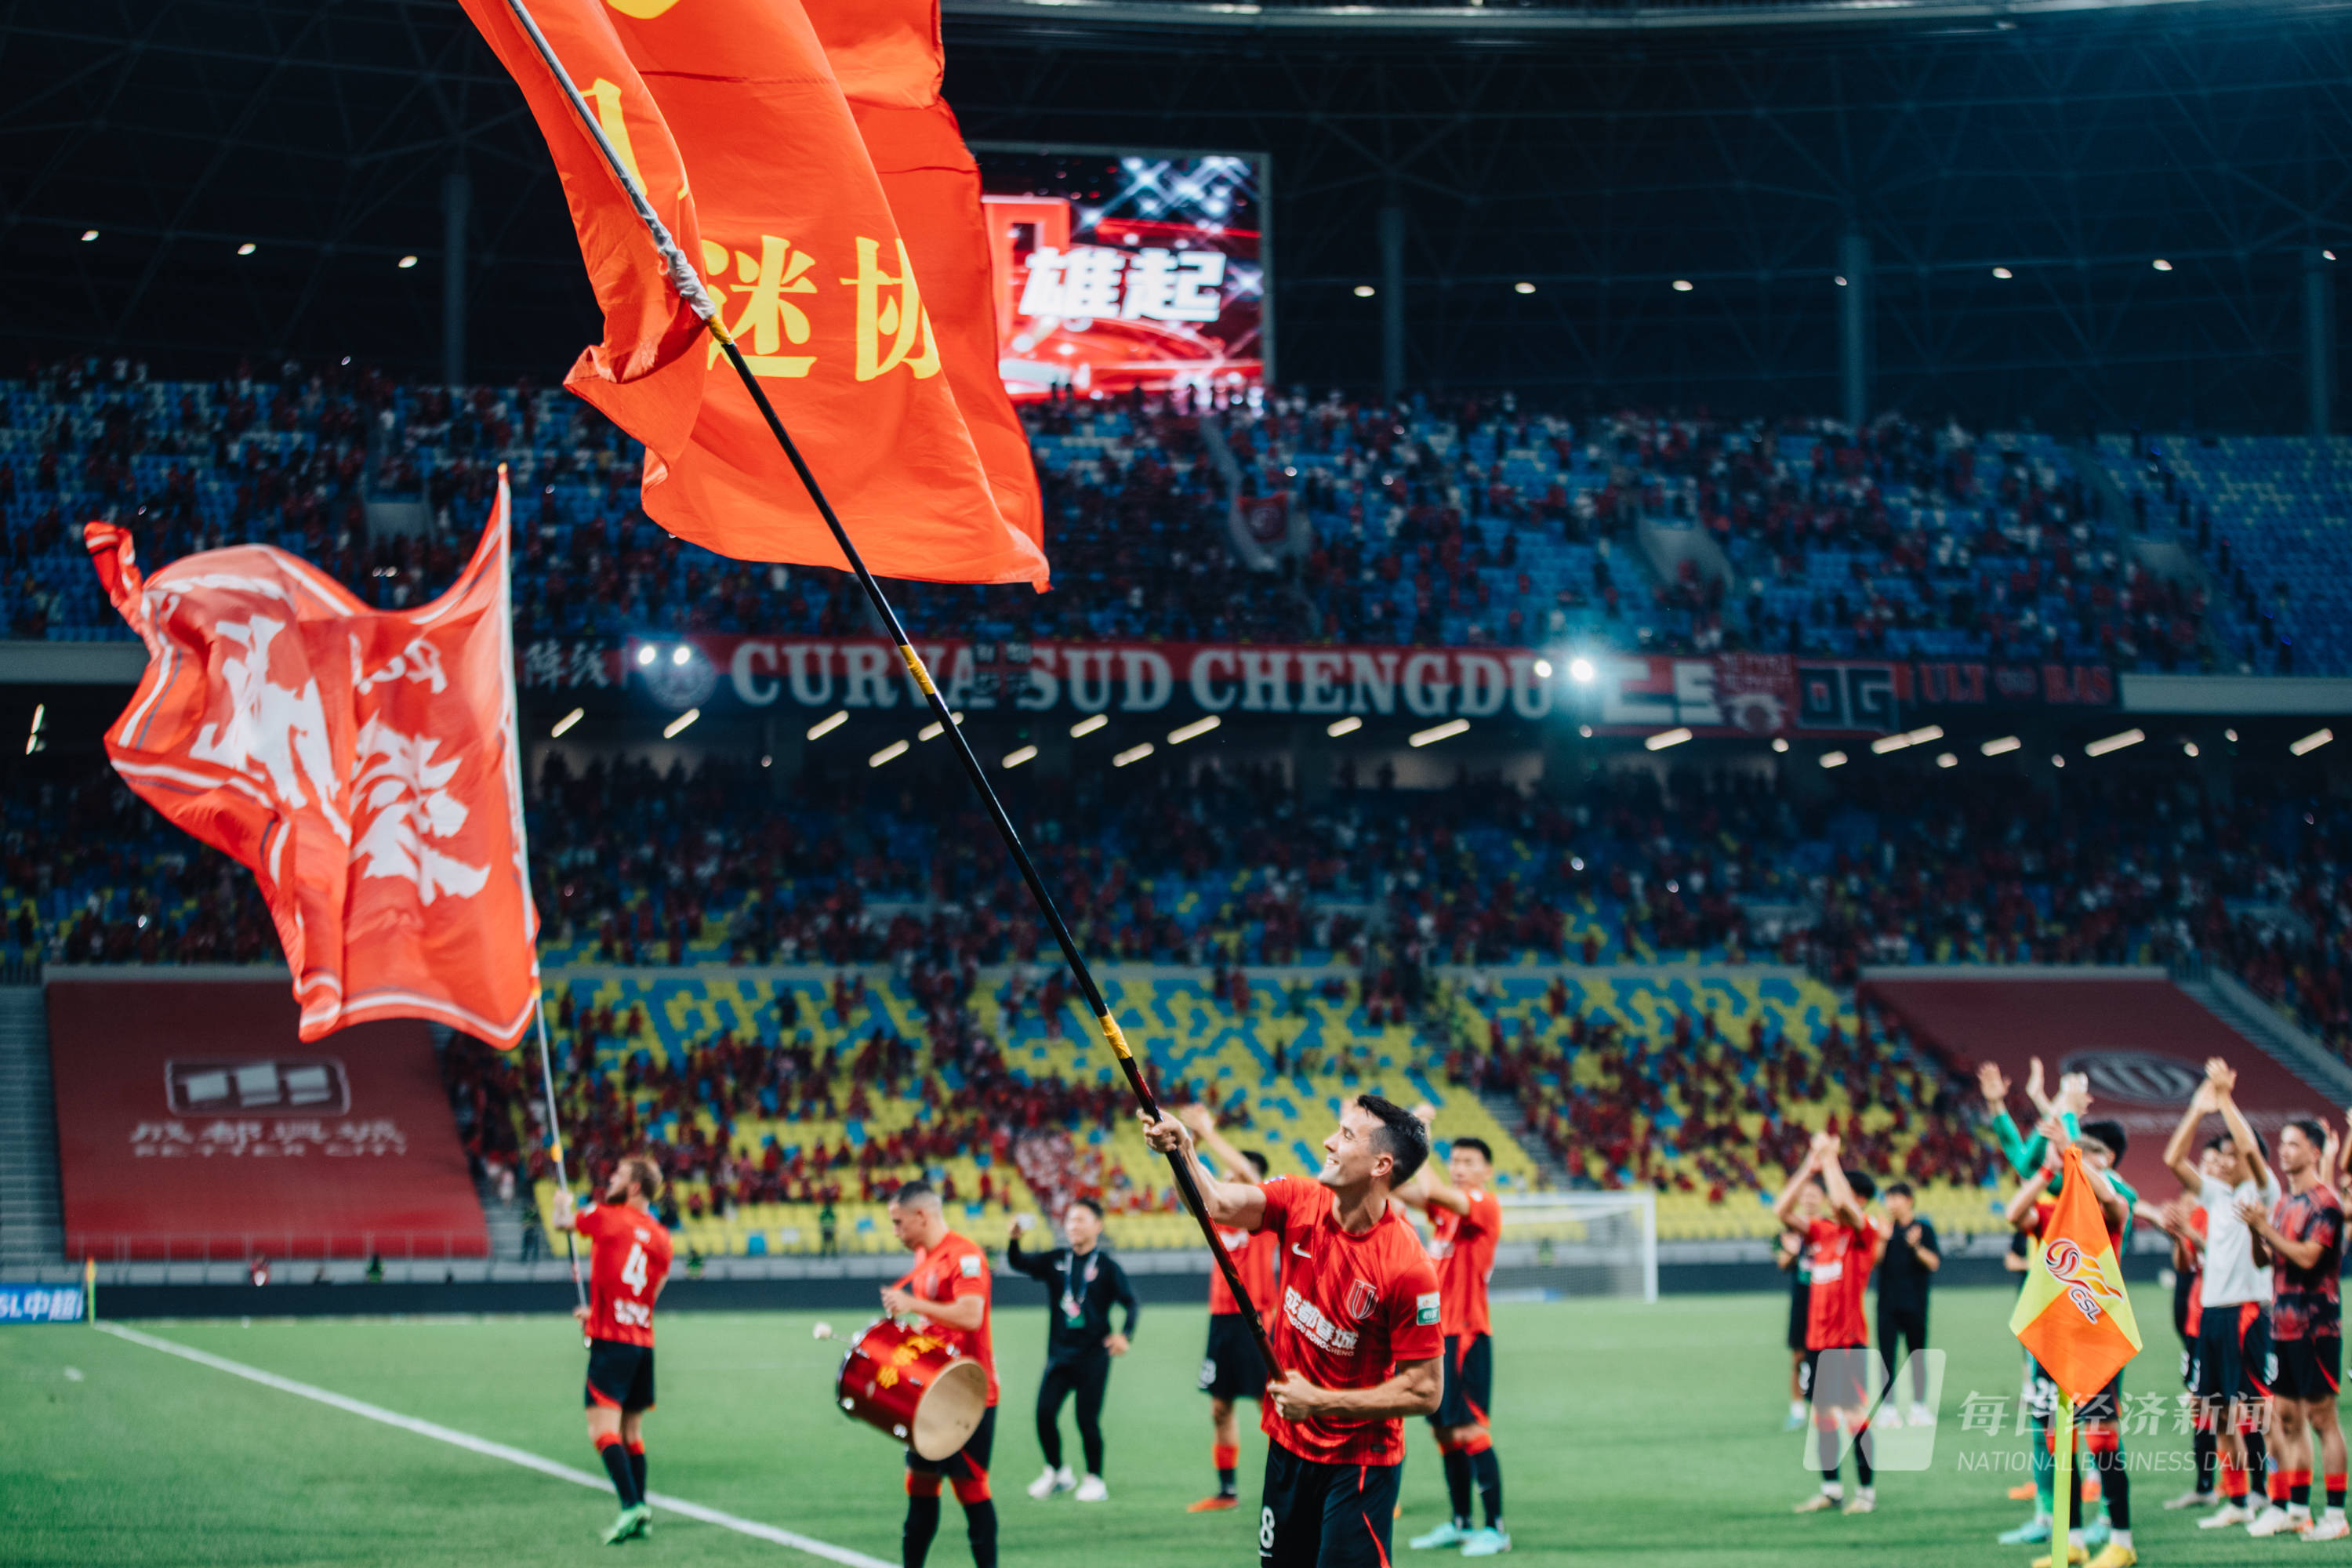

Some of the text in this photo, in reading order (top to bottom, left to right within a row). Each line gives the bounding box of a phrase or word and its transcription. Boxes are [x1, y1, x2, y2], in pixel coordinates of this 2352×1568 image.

[1019, 245, 1226, 322] 雄起
[1189, 648, 1555, 719] CHENGDU
[621, 1242, 648, 1297] 4
[2069, 1287, 2102, 1323] CSL
[1259, 1505, 1276, 1549] 8
